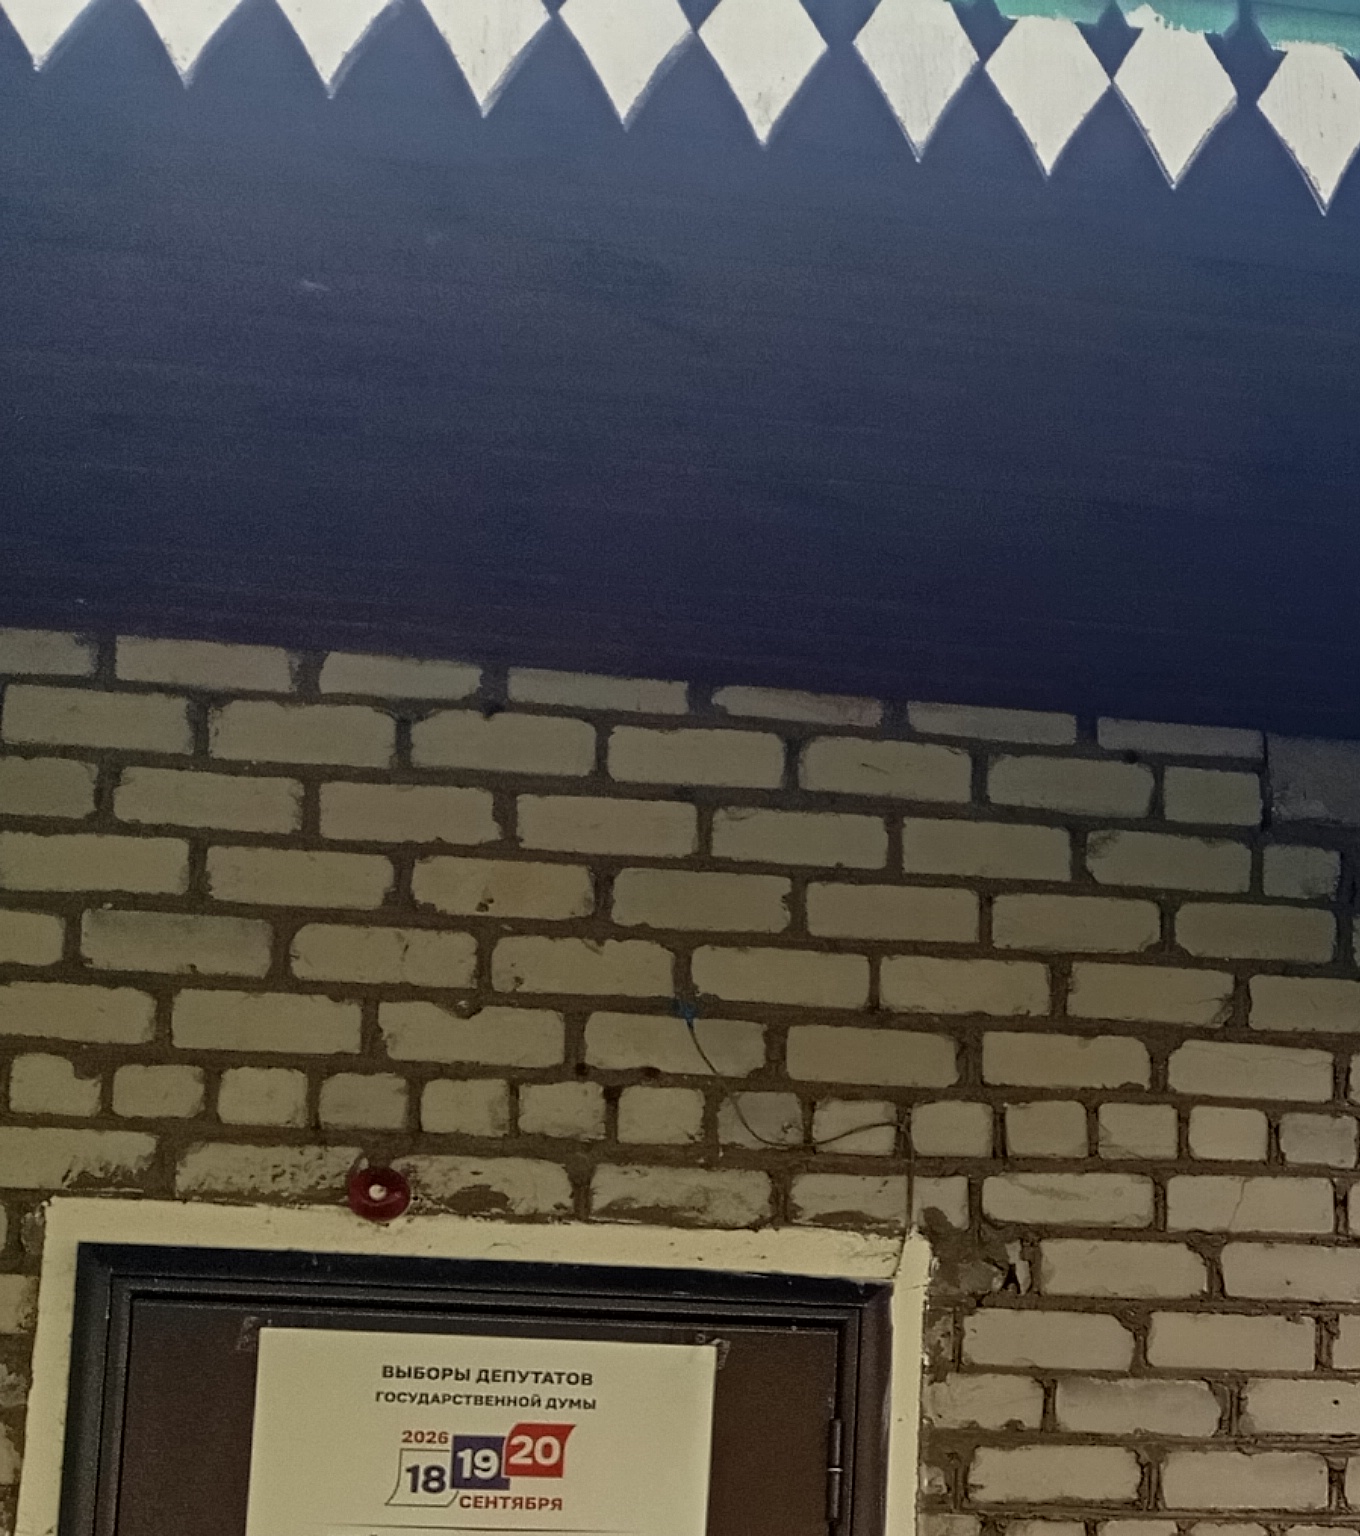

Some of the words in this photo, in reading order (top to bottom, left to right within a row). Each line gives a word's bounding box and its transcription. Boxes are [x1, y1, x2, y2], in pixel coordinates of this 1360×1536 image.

[381, 1365, 470, 1382] ВЫБОРЫ
[476, 1369, 594, 1387] ДЕПУТАТОВ
[375, 1391, 542, 1408] ГОСУДАРСТВЕННОЙ
[545, 1397, 597, 1411] ДУМЫ
[401, 1430, 449, 1445] 2026
[405, 1464, 448, 1495] 18
[456, 1448, 500, 1480] 19
[508, 1435, 562, 1467] 20
[459, 1495, 564, 1511] СЕНТЯБРЯ
